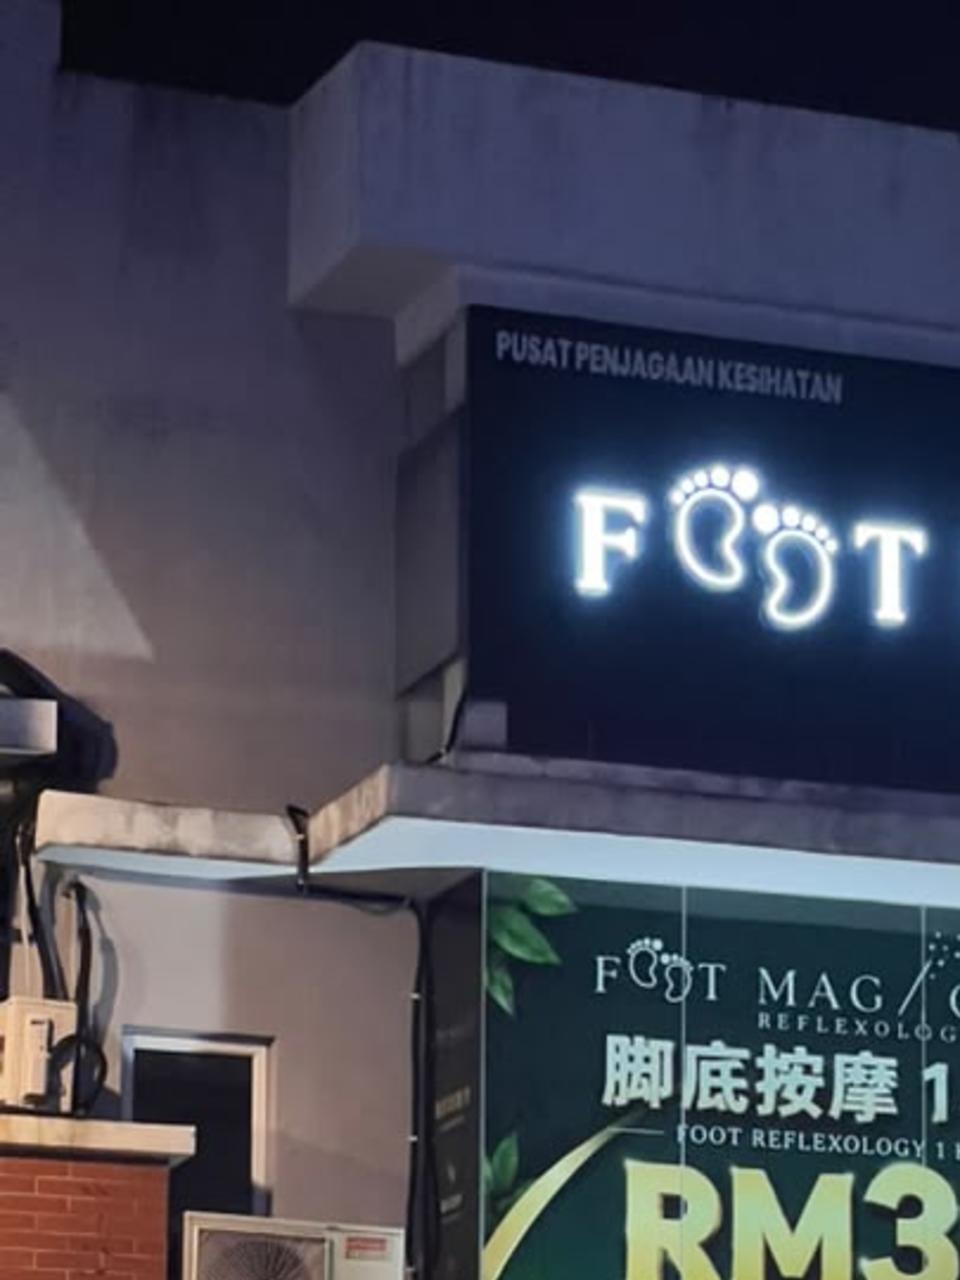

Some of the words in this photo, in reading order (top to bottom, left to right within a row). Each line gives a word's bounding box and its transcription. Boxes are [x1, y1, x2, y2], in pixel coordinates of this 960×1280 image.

[496, 331, 570, 369] PUSAT
[575, 344, 714, 389] PENJAGAAN
[717, 361, 843, 403] KESIHATAN
[602, 1033, 900, 1124] 脚底按摩
[676, 1123, 743, 1148] FOOT
[750, 1128, 926, 1160] REFLEXOLOGY
[935, 1143, 946, 1161] 1
